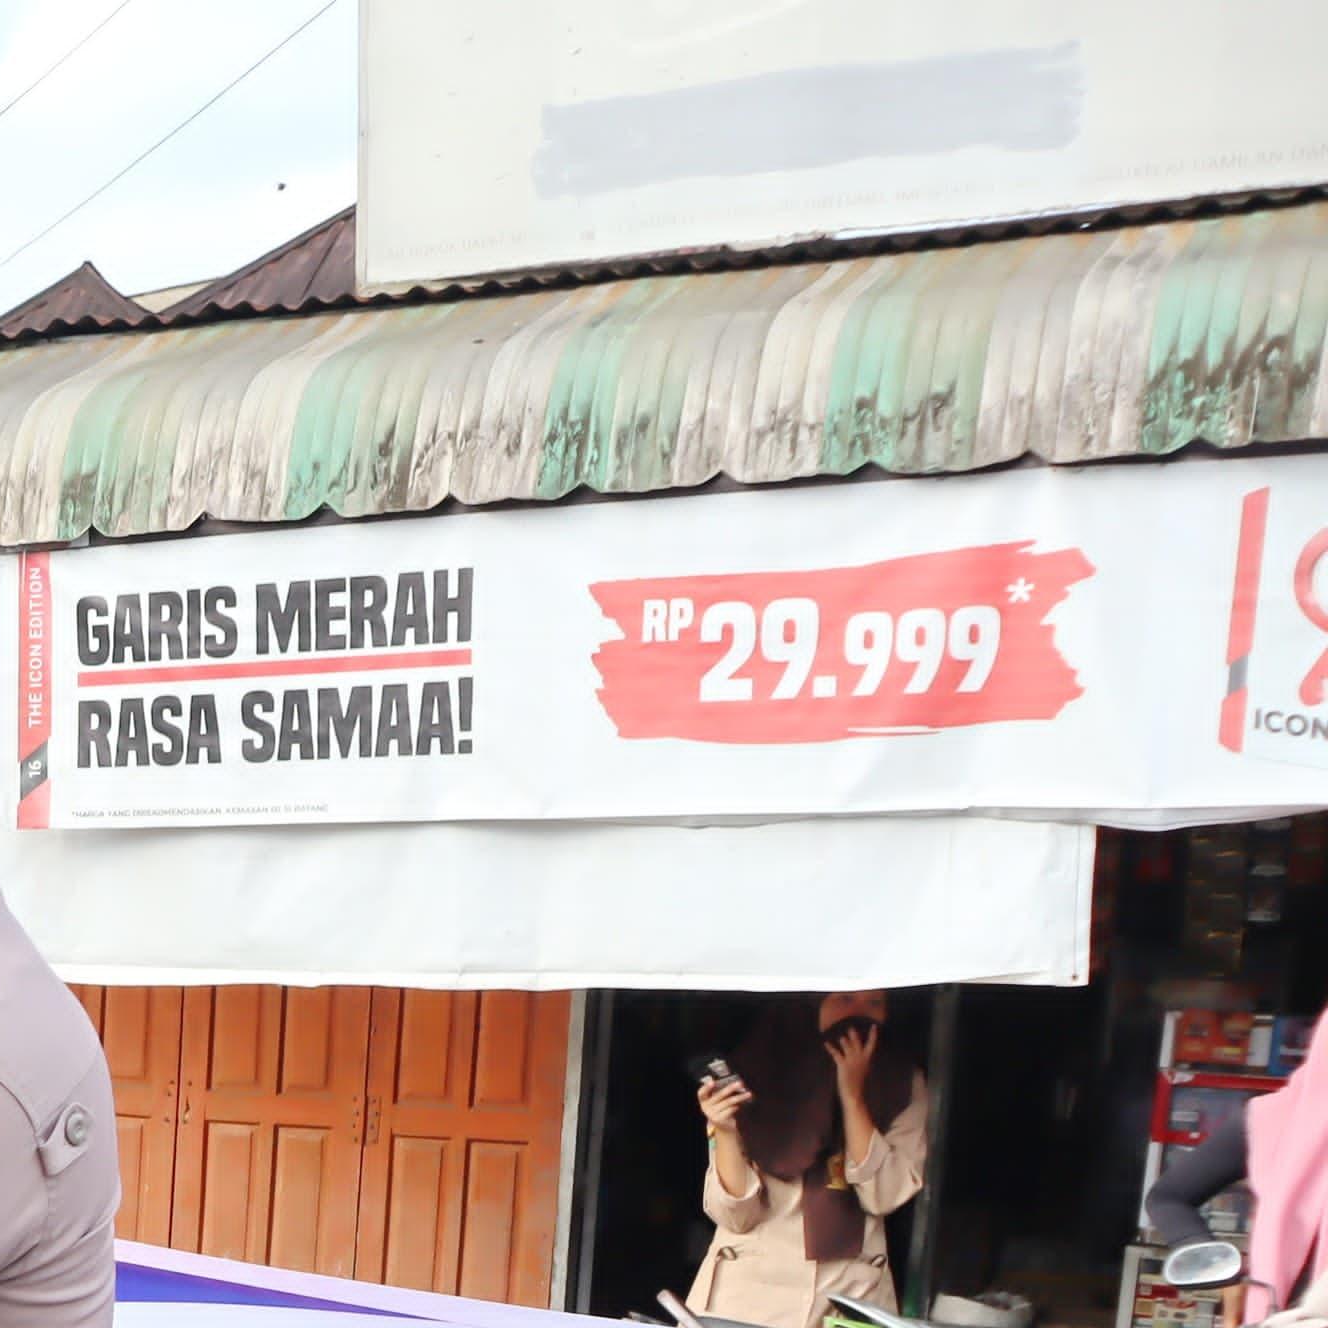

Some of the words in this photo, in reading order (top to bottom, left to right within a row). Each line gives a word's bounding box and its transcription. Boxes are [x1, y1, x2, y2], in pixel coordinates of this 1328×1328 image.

[27, 566, 43, 640] EDITION
[75, 586, 239, 667] GARIS
[255, 567, 475, 656] MERAH
[642, 597, 694, 644] RP
[27, 643, 43, 689] ICON
[27, 695, 43, 729] THE
[77, 694, 223, 769] RASA
[240, 676, 475, 765] SAMAA!
[27, 759, 43, 779] 16
